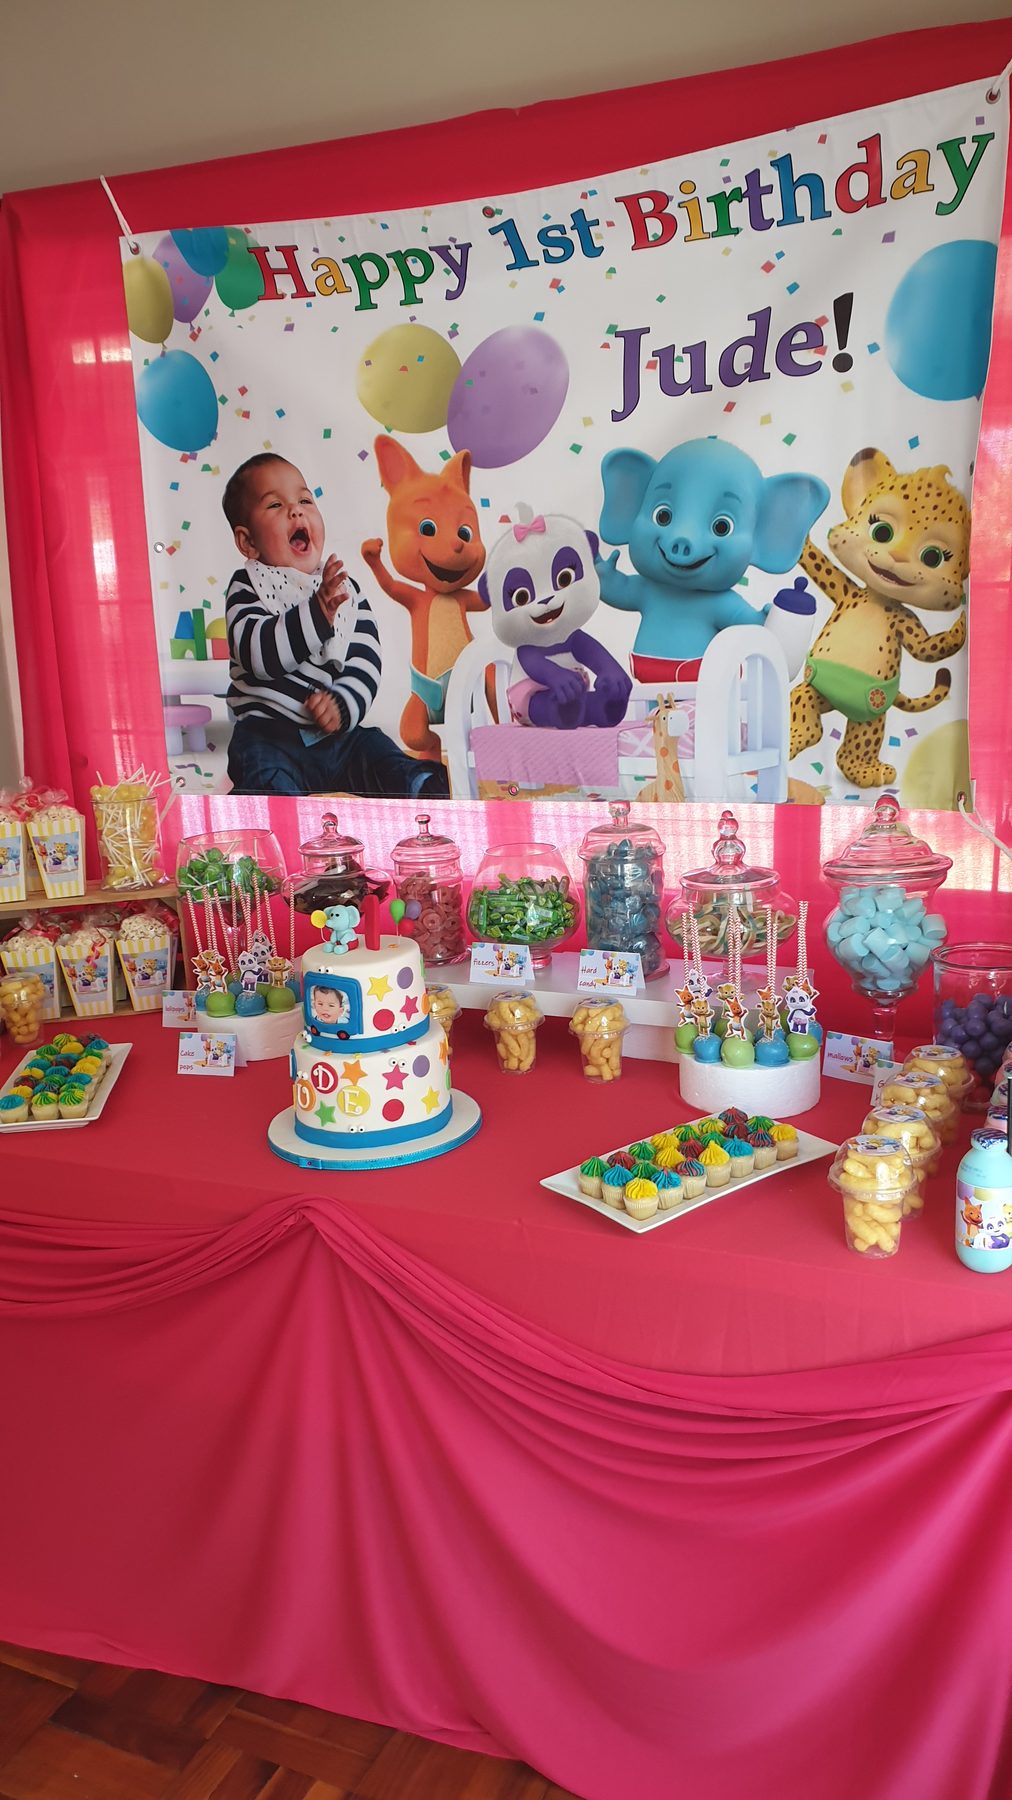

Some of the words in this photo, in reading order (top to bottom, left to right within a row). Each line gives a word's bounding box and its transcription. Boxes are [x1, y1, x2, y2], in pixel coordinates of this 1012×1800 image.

[247, 242, 472, 311] Happy
[488, 208, 604, 271] 1st
[615, 133, 995, 251] Birthday
[611, 292, 854, 422] Jude!
[581, 966, 597, 975] Hard
[180, 1049, 195, 1057] Cake
[827, 1051, 853, 1063] mallows
